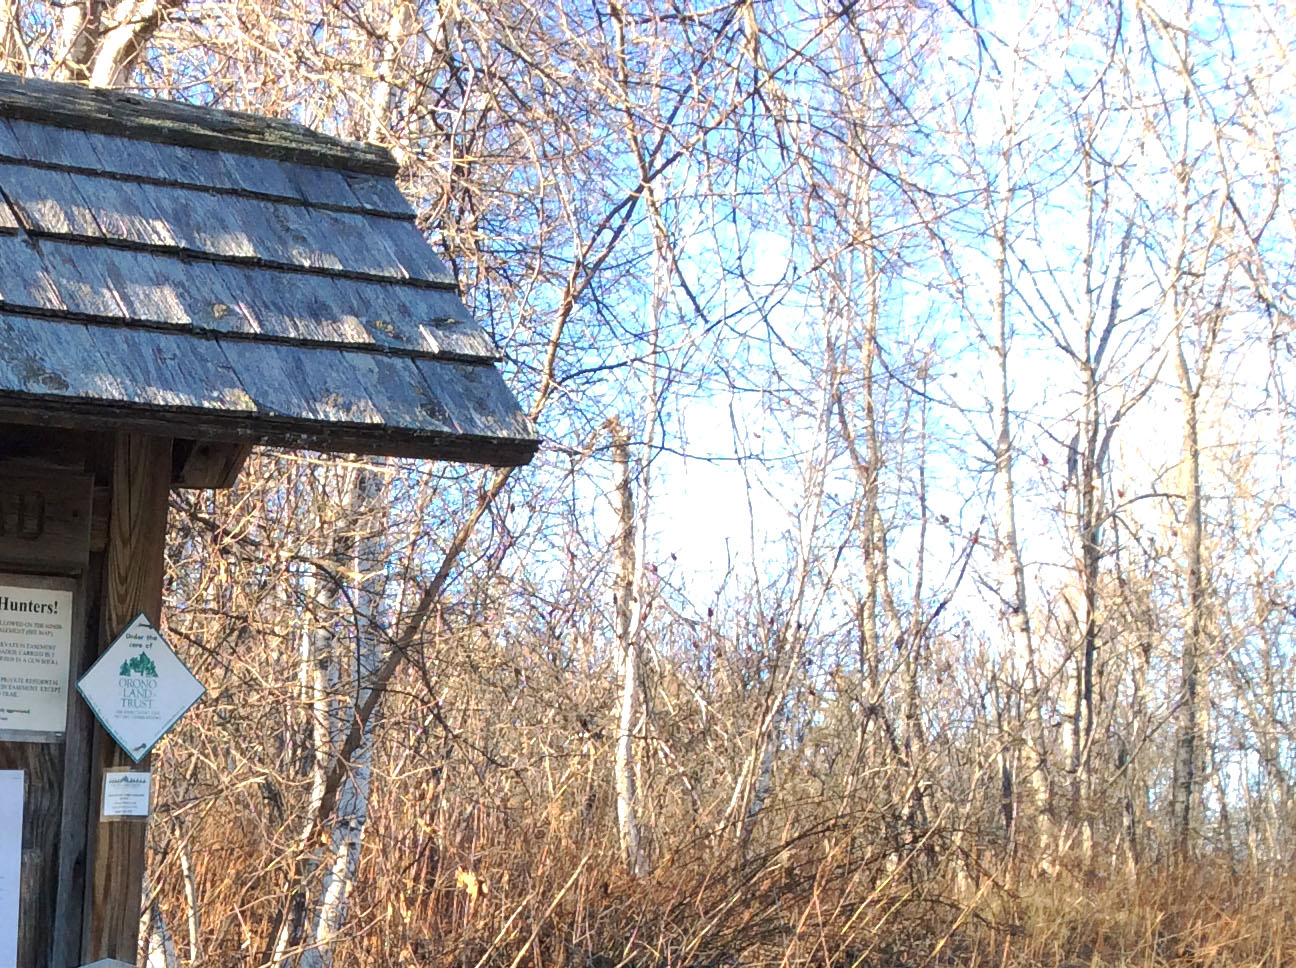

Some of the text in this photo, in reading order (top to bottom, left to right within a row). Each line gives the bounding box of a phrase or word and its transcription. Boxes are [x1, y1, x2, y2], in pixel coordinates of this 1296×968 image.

[125, 632, 144, 640] Under
[118, 679, 158, 690] ORONO
[122, 688, 153, 699] LAND
[120, 698, 153, 709] TRUST
